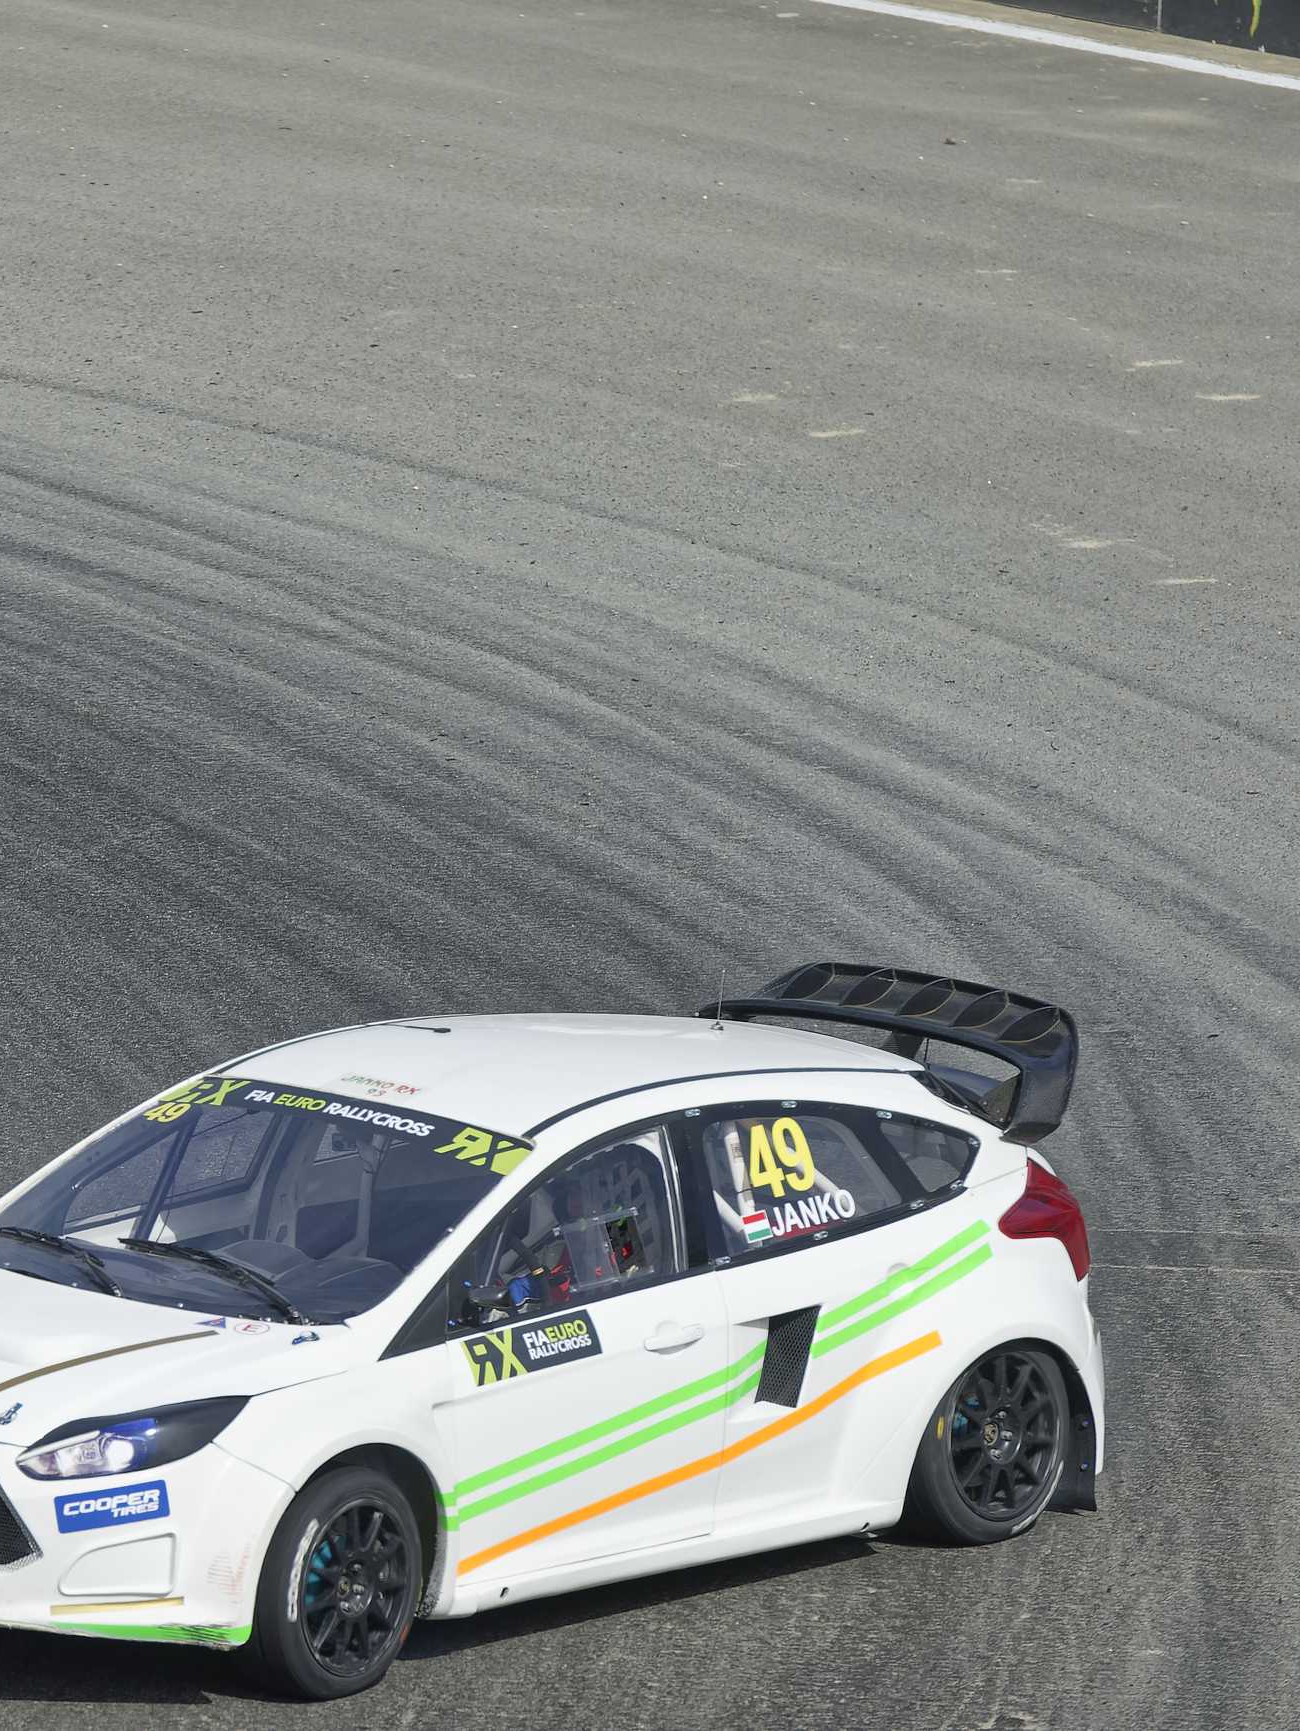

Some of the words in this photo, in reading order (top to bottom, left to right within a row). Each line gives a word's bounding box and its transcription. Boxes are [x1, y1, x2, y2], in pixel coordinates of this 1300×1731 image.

[142, 1101, 191, 1123] 49
[244, 1089, 273, 1104] FIA
[273, 1094, 327, 1112] EURO
[322, 1102, 436, 1137] RALLYCROSS
[750, 1116, 816, 1198] 49
[772, 1189, 856, 1237] JANKO
[528, 1334, 592, 1360] RALLYCROSS
[63, 1488, 161, 1517] COOPER
[111, 1502, 160, 1519] TIRES
